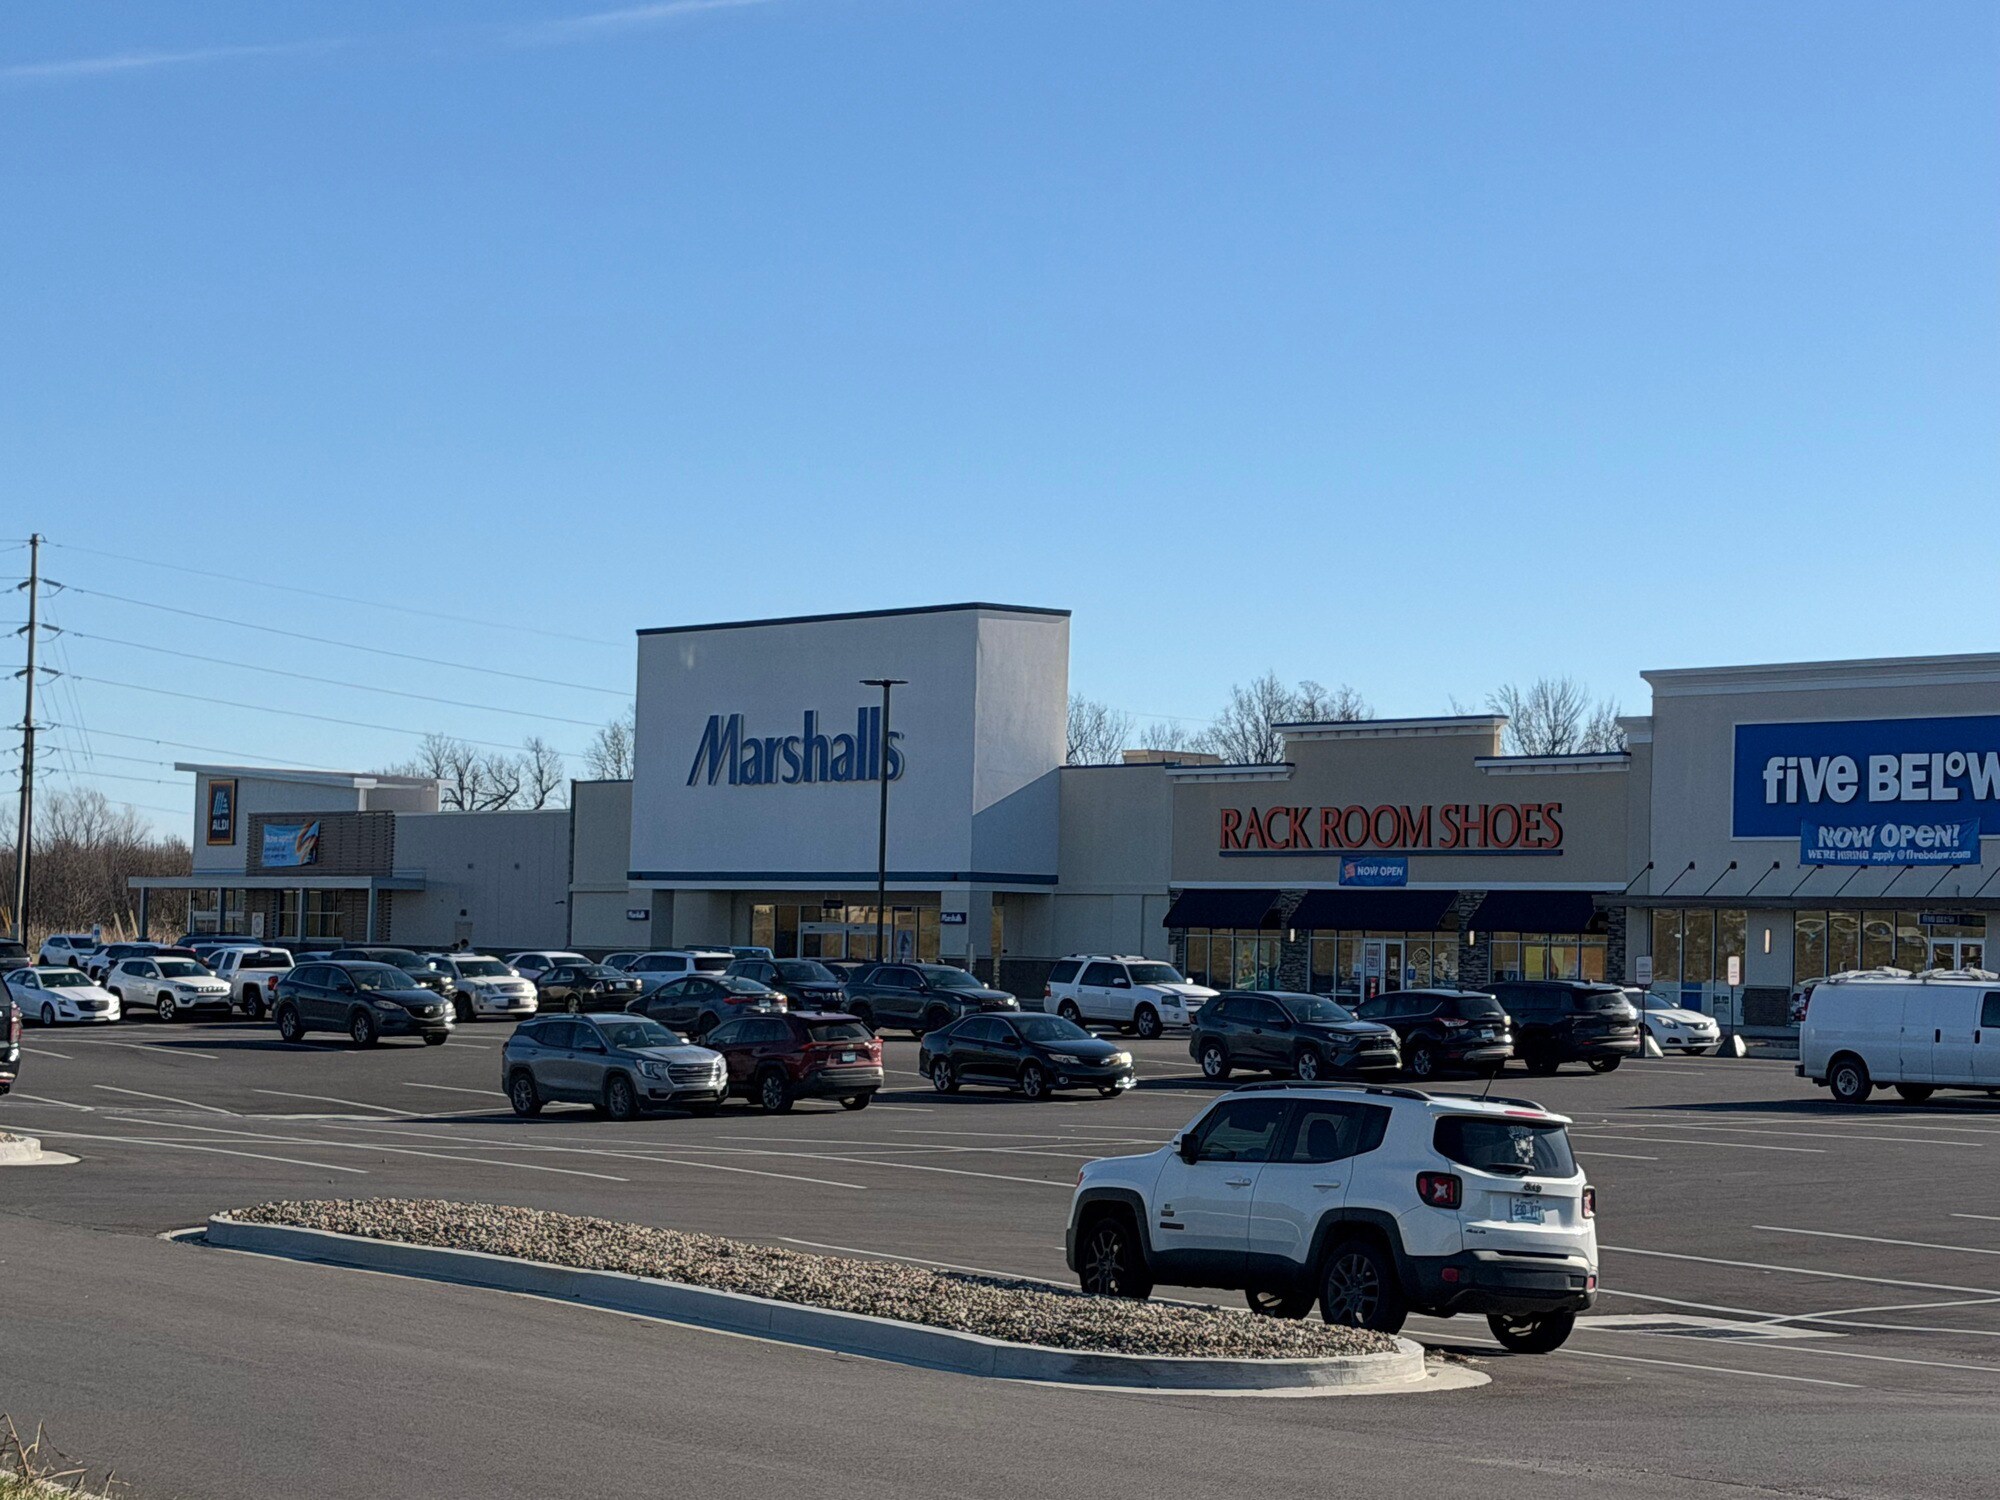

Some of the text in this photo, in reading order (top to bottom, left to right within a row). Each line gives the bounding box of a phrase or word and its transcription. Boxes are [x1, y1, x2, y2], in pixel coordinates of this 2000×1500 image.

[686, 706, 904, 786] Marshalls
[1762, 755, 1859, 803] five
[212, 819, 229, 831] ALDI
[1220, 803, 1563, 849] RACK ROOM SHOES
[1818, 825, 1877, 848] NOW
[1357, 866, 1378, 876] NOW
[1380, 866, 1404, 876] OPEN
